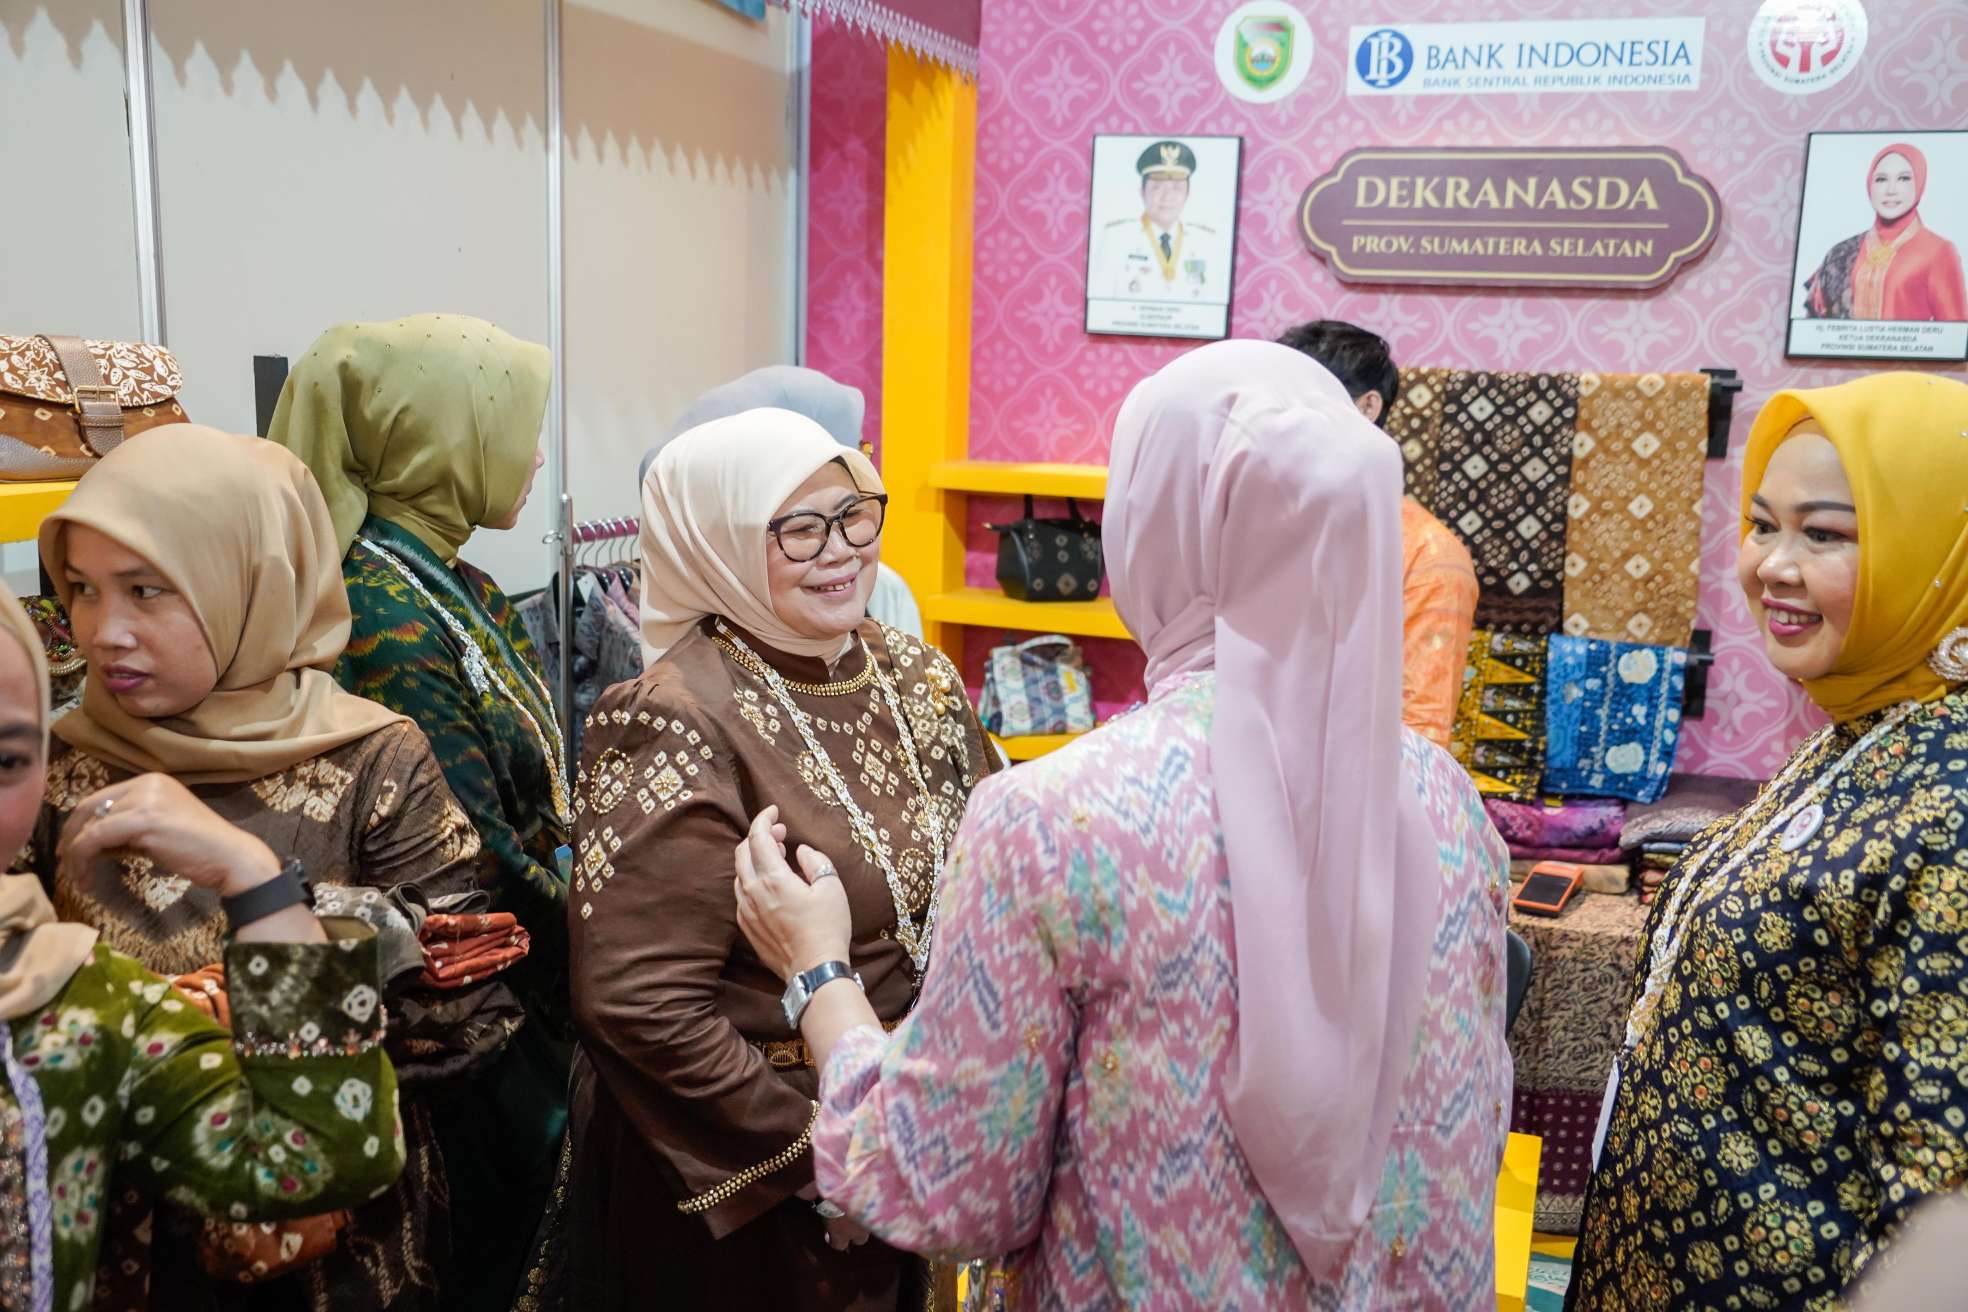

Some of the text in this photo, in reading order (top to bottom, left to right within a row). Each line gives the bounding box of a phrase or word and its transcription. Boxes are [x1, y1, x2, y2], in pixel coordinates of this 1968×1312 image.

[1426, 40, 1692, 70] BANK INDONESIA
[1423, 73, 1692, 89] BANK SENTRAL REPUBLIK INDONESIA
[1355, 175, 1660, 210] DEKRANASDA
[1351, 235, 1654, 257] PROV. SUMATERA SELATAN
